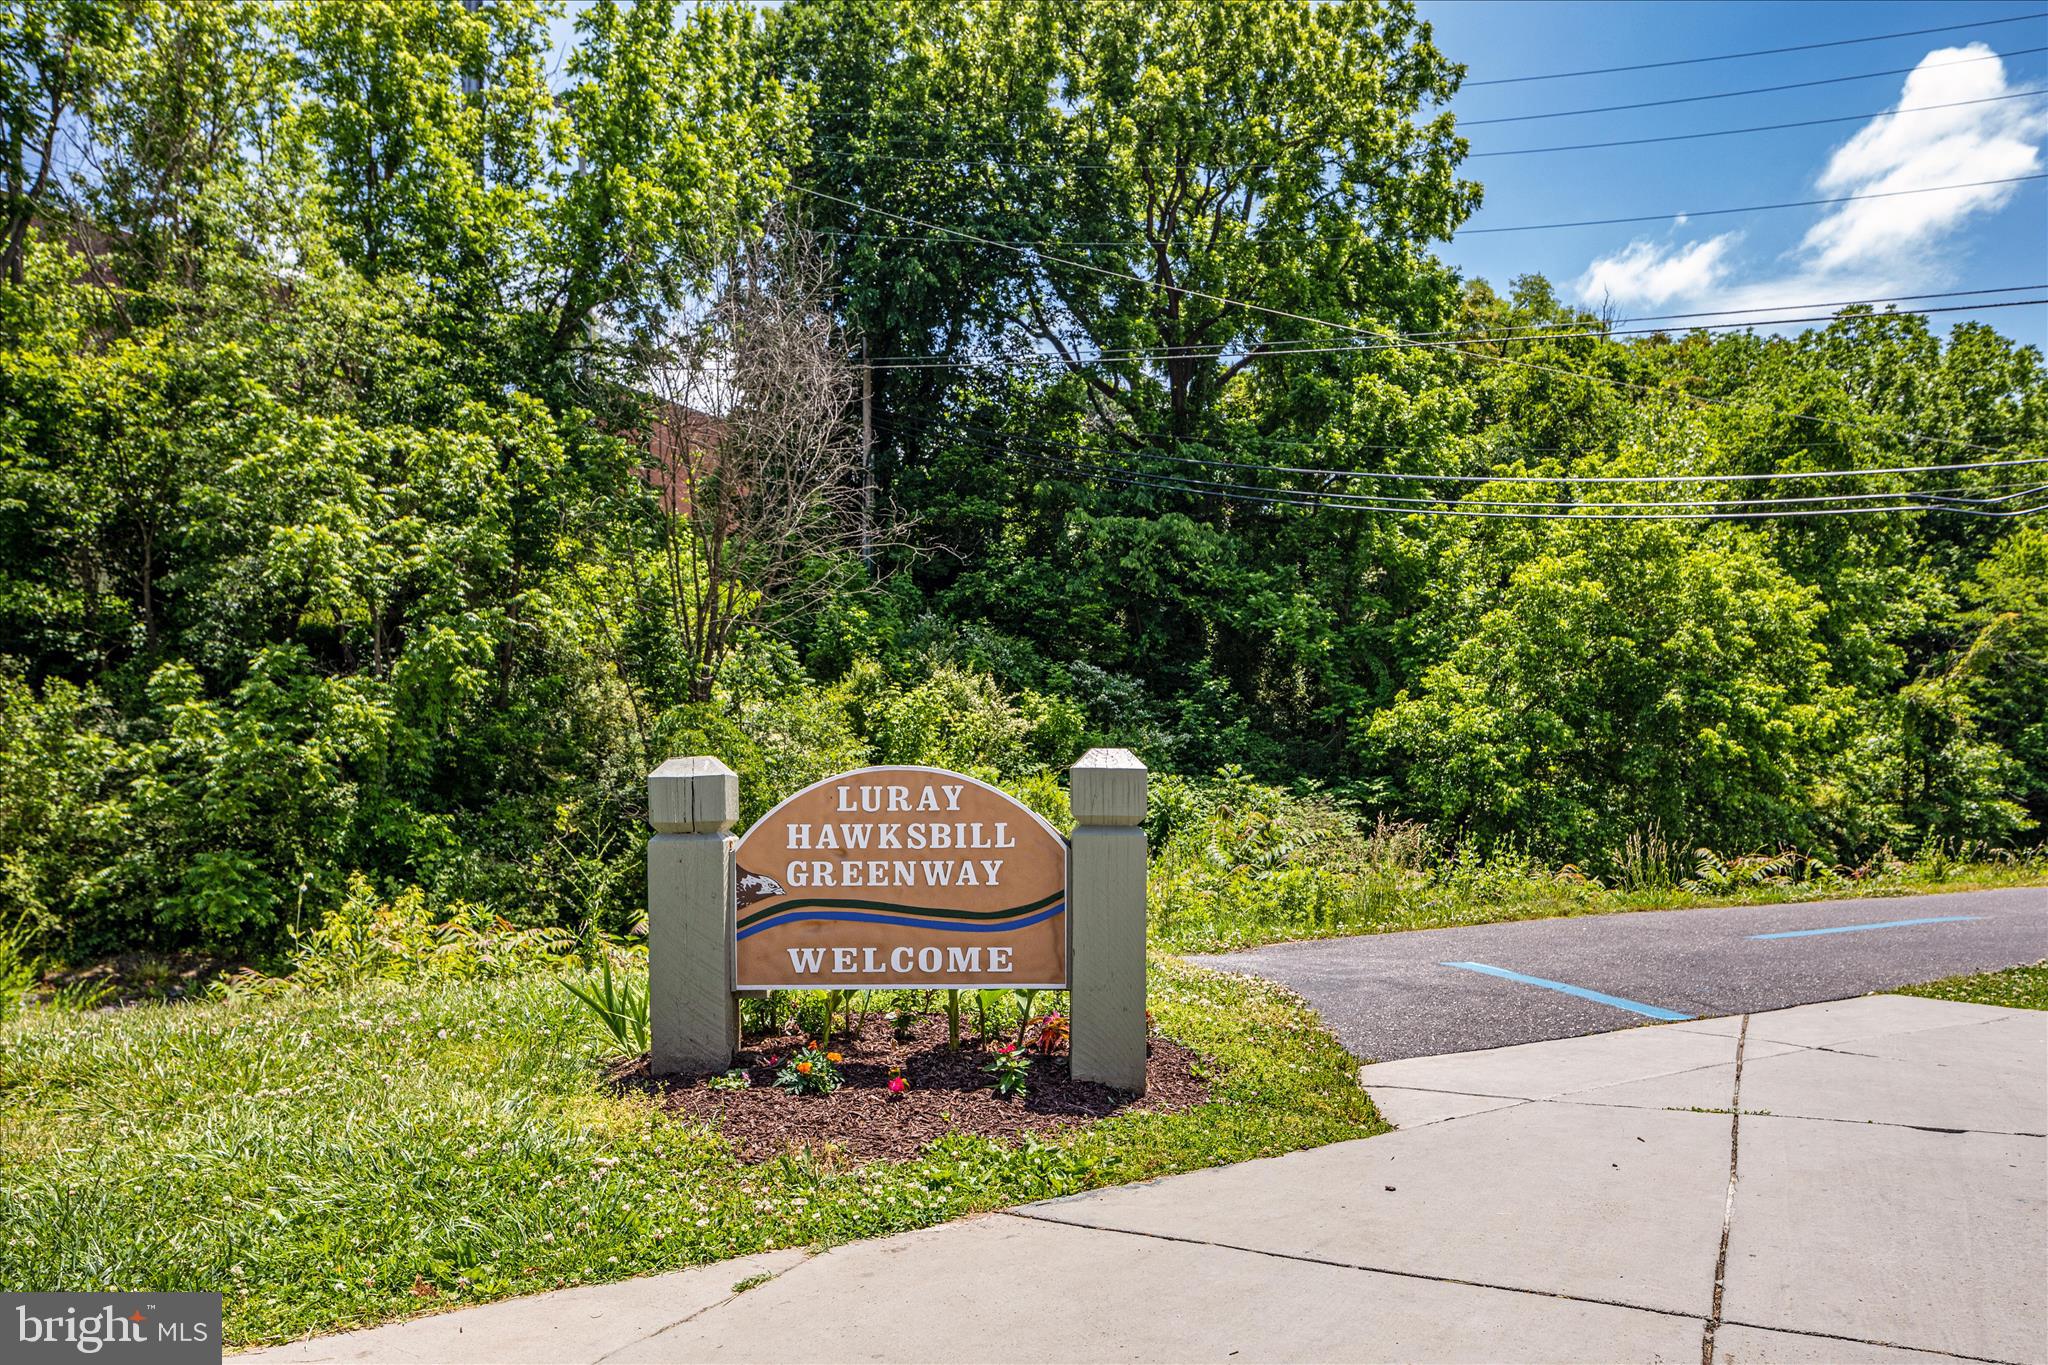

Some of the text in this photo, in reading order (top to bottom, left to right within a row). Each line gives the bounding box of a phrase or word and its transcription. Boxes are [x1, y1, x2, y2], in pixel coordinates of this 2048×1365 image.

[836, 785, 964, 813] LURAY
[786, 823, 1016, 850] HAWKSBILL
[786, 860, 1004, 888] GREENWAY
[787, 946, 1014, 974] WELCOME
